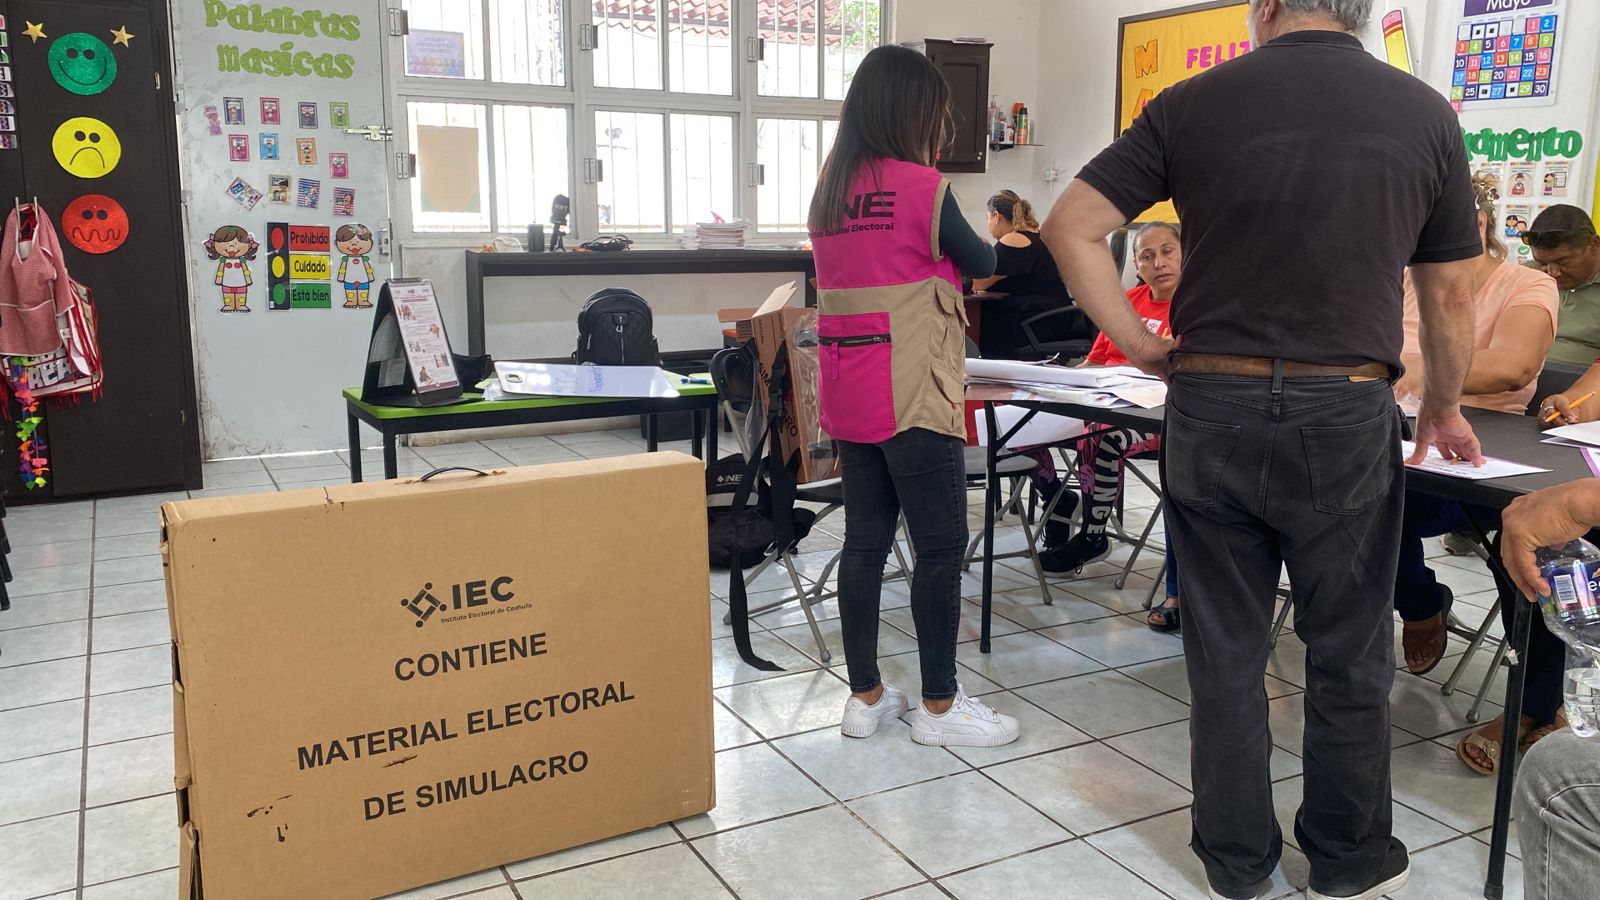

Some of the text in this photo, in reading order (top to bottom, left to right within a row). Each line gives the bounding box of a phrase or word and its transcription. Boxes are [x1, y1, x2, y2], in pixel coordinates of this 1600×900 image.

[203, 0, 361, 41] Palabras
[1543, 19, 1550, 27] 2
[1459, 43, 1465, 51] 3
[1485, 40, 1491, 48] 5
[1500, 39, 1506, 47] 6
[1513, 38, 1519, 46] 7
[1543, 36, 1549, 44] 9
[1456, 60, 1464, 68] 10
[1483, 57, 1491, 65] 12
[1510, 54, 1519, 62] 14
[1525, 52, 1534, 60] 15
[1538, 51, 1547, 59] 16
[1456, 67, 1547, 81] 17 18 19 20 21 22 23
[1465, 88, 1475, 96] 25
[1492, 87, 1501, 95] 27
[1521, 85, 1531, 93] 29
[1534, 84, 1545, 93] 30
[843, 191, 897, 220] NE
[851, 222, 894, 233] Electoral
[290, 231, 329, 244] Prohibido
[294, 260, 326, 272] Cuidado
[312, 289, 330, 302] bien
[452, 576, 515, 610] IEC
[440, 614, 467, 624] Instituto
[468, 609, 496, 619] Electoral
[506, 602, 533, 612] Coahuila
[394, 632, 549, 682] CONTIENE
[297, 681, 636, 771] MATERIAL ELECTORAL
[363, 750, 590, 821] DE SIMULACRO
